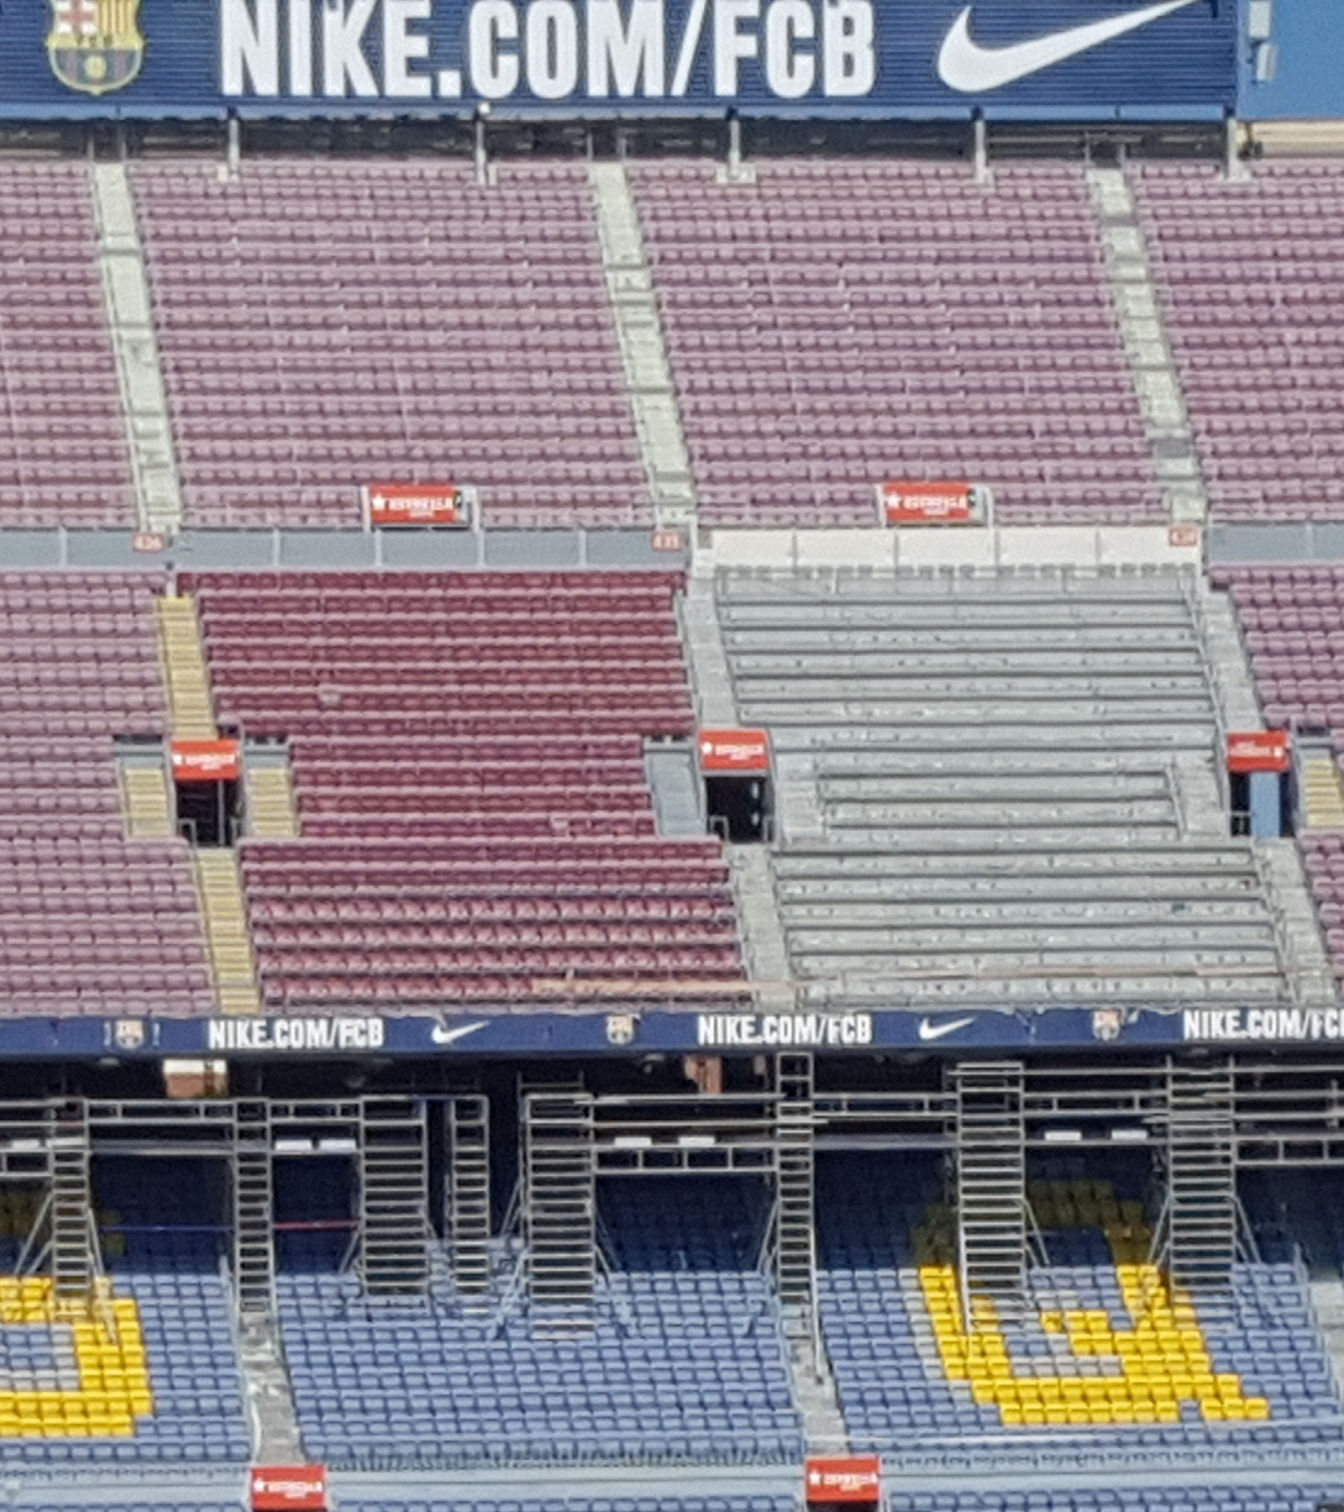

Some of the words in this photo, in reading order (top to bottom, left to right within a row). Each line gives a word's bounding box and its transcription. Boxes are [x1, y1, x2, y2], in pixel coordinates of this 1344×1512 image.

[221, 0, 874, 97] NIKE.COM/FCB
[208, 1017, 383, 1048] NIKE.COM/FCB
[698, 1013, 871, 1044] NIKE.COM/FCB
